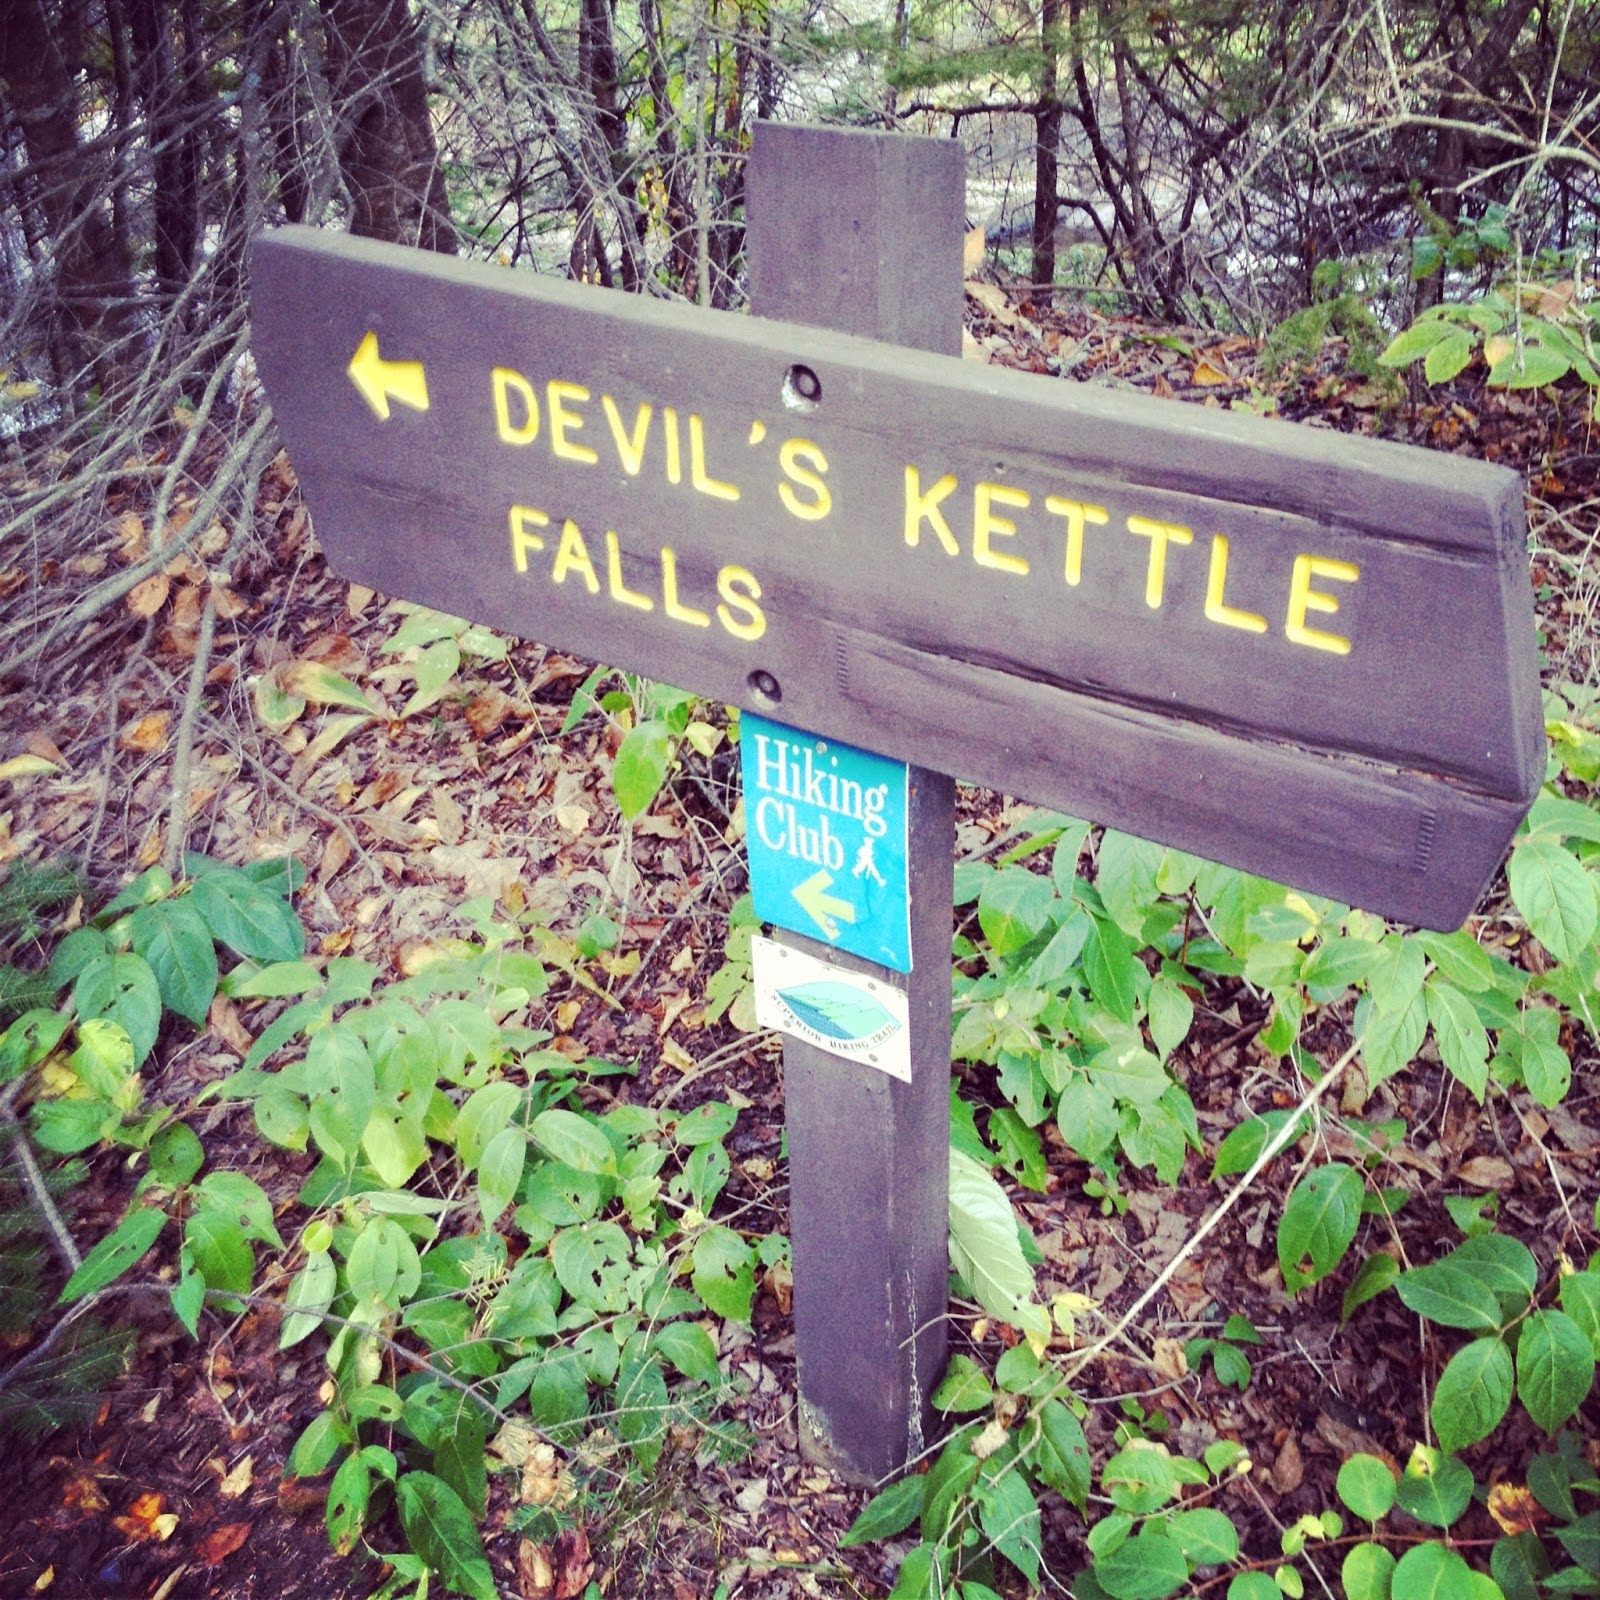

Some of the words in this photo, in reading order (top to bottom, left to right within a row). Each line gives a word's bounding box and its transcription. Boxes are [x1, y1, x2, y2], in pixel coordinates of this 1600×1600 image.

[492, 366, 832, 521] DEVIL'S
[904, 463, 1361, 656] KETTLE
[509, 503, 767, 642] FALLS
[754, 733, 888, 838] Hiking
[755, 796, 844, 872] Club
[770, 994, 822, 1043] SUPERIOR
[829, 1038, 870, 1050] HIKING
[871, 1023, 897, 1044] TRAIL
